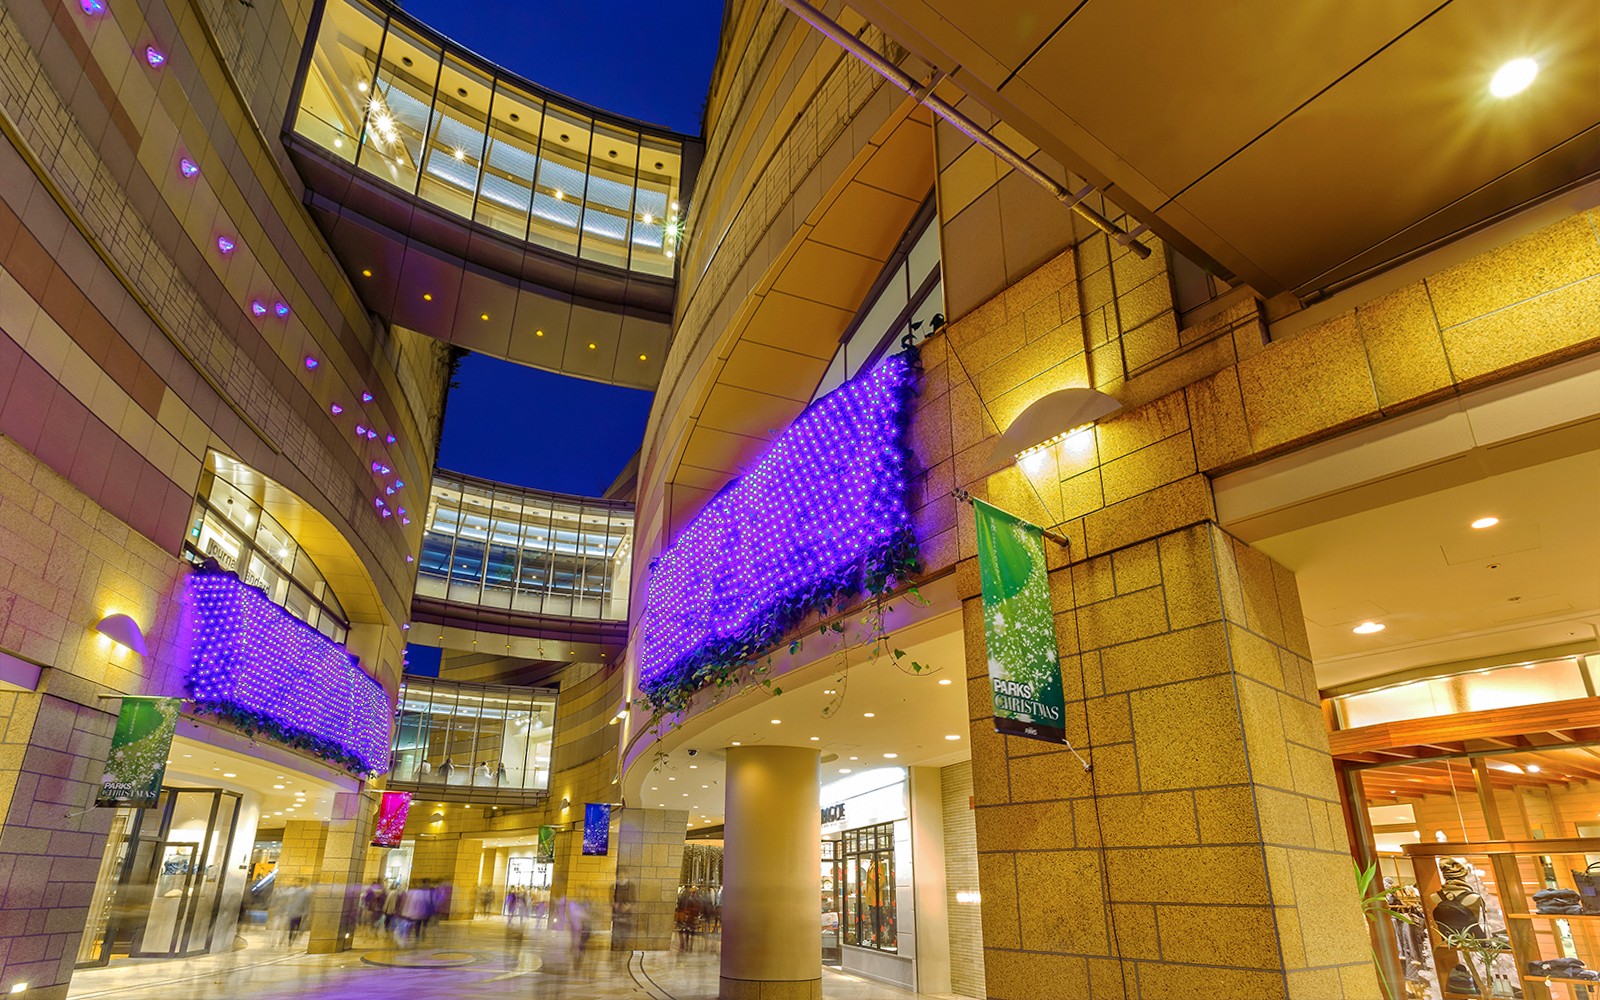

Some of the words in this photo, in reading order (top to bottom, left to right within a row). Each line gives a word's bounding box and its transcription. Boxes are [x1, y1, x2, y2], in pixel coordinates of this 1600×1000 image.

[208, 541, 237, 569] journa
[993, 678, 1032, 699] PARKS
[994, 693, 1059, 721] CHRISTMAS
[101, 789, 157, 799] CHRISTMAS
[103, 782, 133, 790] PARKS
